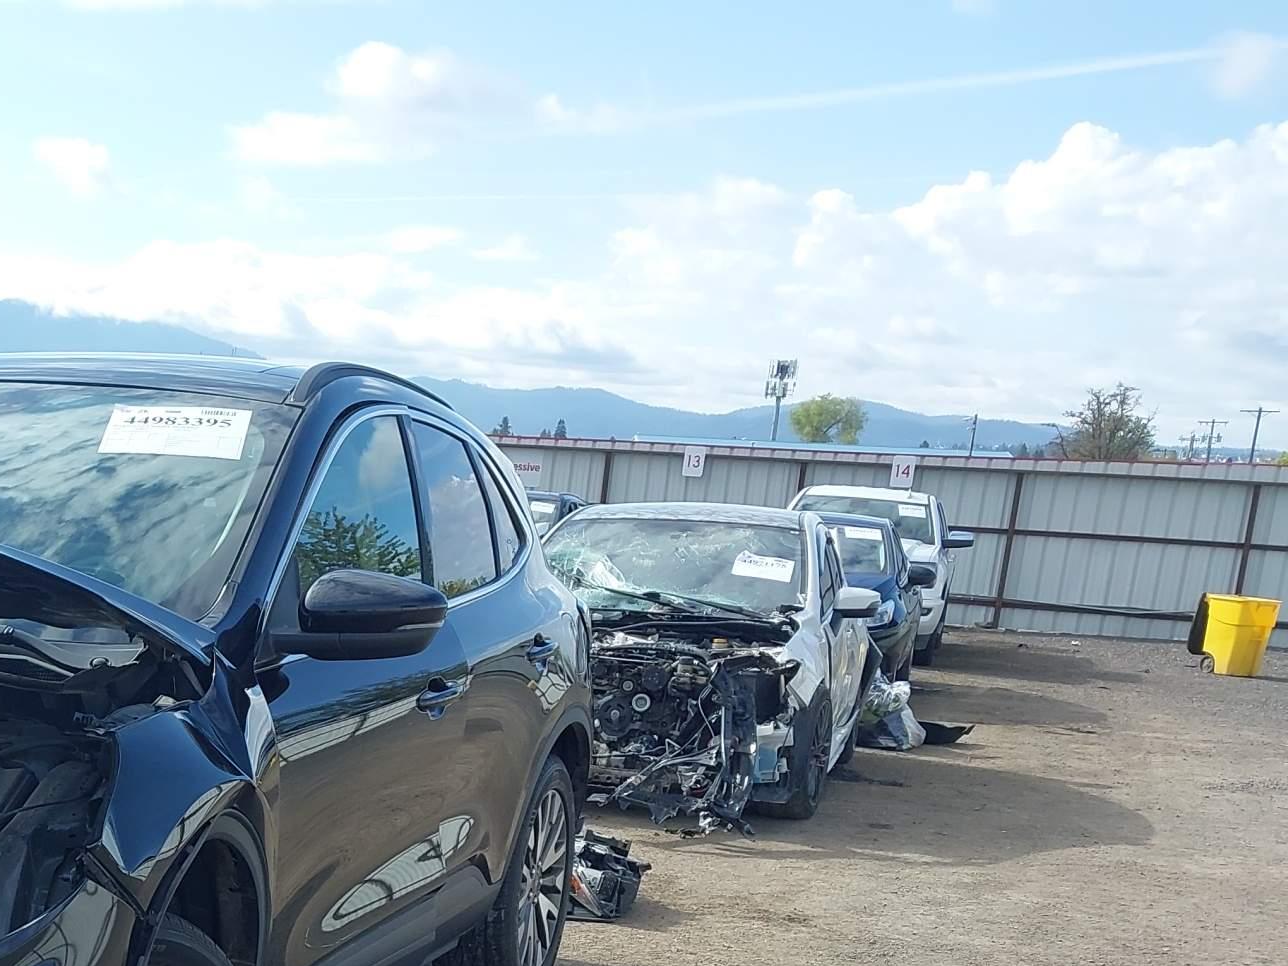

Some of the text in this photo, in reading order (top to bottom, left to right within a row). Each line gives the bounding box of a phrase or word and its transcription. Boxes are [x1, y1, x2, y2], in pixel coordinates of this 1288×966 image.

[123, 415, 233, 428] 44983395
[513, 462, 541, 472] essive
[688, 455, 701, 469] 13
[895, 463, 911, 479] 14
